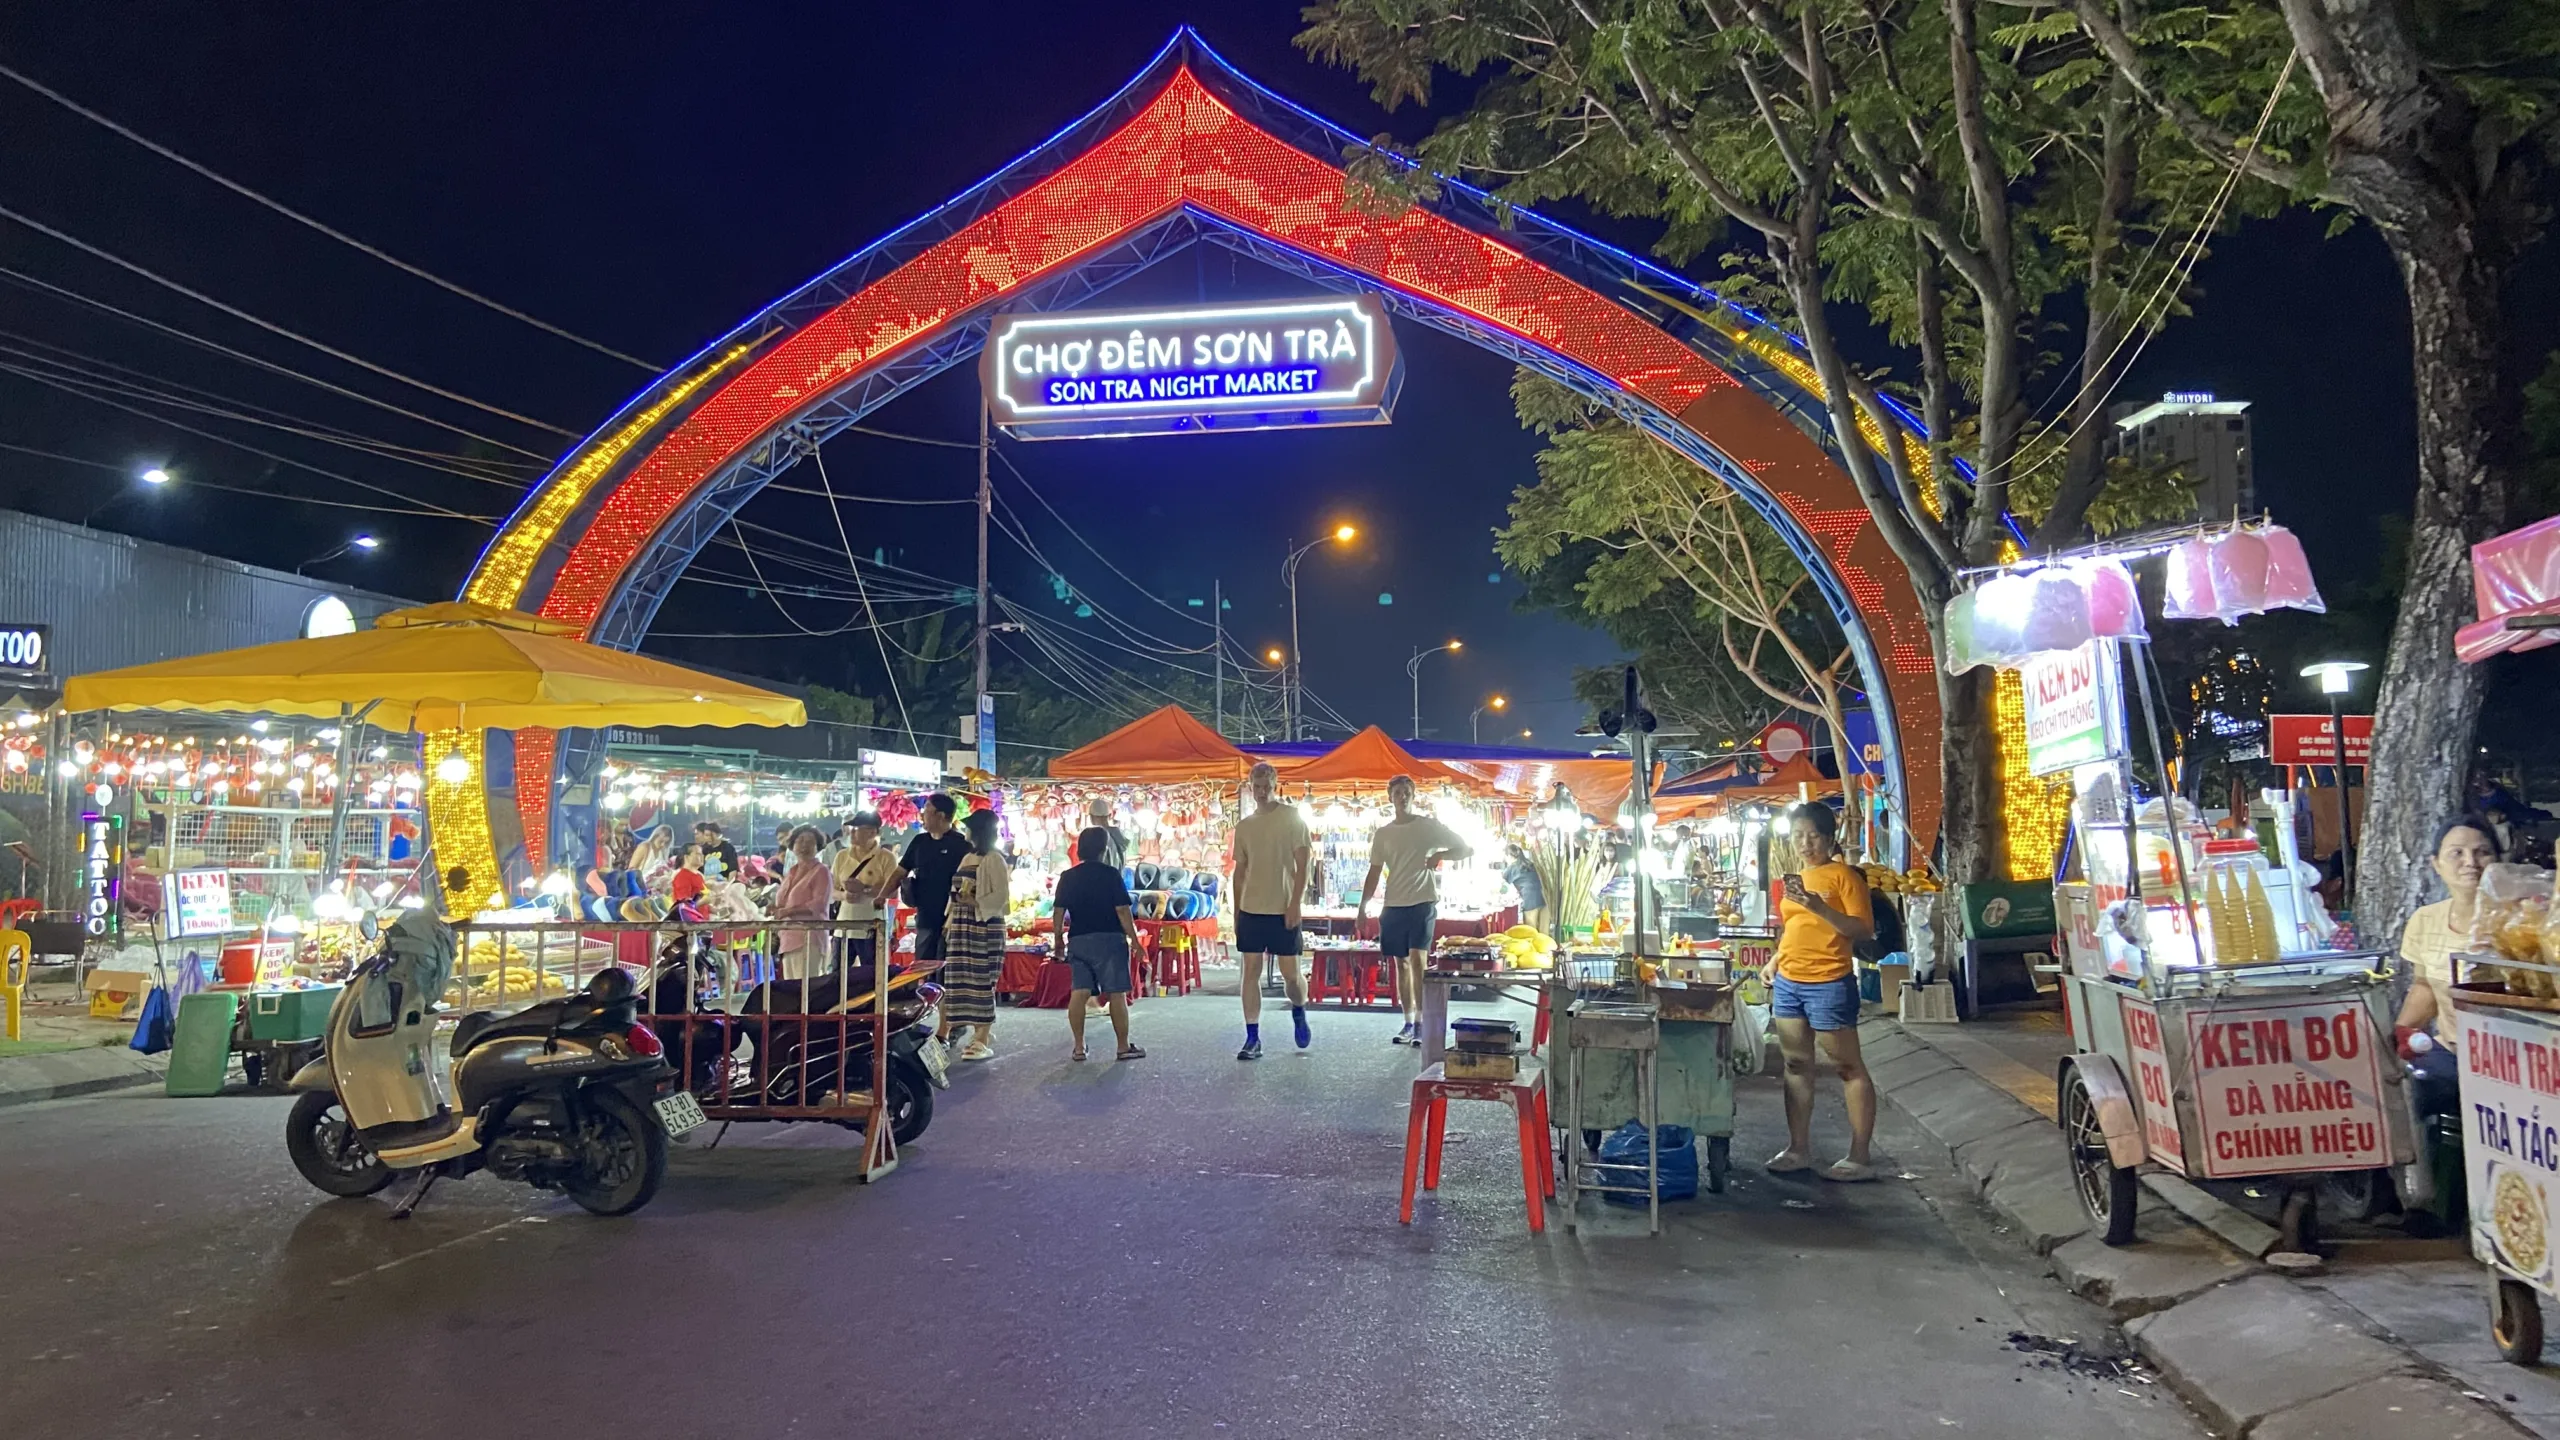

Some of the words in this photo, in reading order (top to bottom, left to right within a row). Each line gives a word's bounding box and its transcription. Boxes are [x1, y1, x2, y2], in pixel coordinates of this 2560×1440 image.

[1012, 339, 1090, 378] CHỢ
[1099, 330, 1182, 370] ĐÊM
[1194, 331, 1273, 366] SƠN
[1285, 319, 1357, 361] TRÀ
[1049, 381, 1095, 404] SON
[1101, 379, 1144, 401] TRA
[1149, 374, 1219, 398] NIGHT
[1224, 369, 1317, 394] MARKET
[2176, 394, 2213, 403] HIYORI
[1863, 743, 1884, 762] CH
[88, 822, 110, 935] TATTOO
[2129, 1007, 2161, 1051] KEM
[2200, 1019, 2293, 1069] KEM
[2303, 1008, 2360, 1062] BƠ
[2467, 1021, 2521, 1086] BÁNH
[660, 1094, 692, 1116] 92-B1
[2226, 1079, 2267, 1117] ĐÀ
[2272, 1071, 2354, 1114] NẴNG
[665, 1108, 705, 1133] 549.59
[2215, 1122, 2303, 1161] CHÍNH
[2310, 1116, 2376, 1160] HIỆU
[2475, 1102, 2513, 1156] TRÀ
[2517, 1105, 2558, 1172] TẮC
